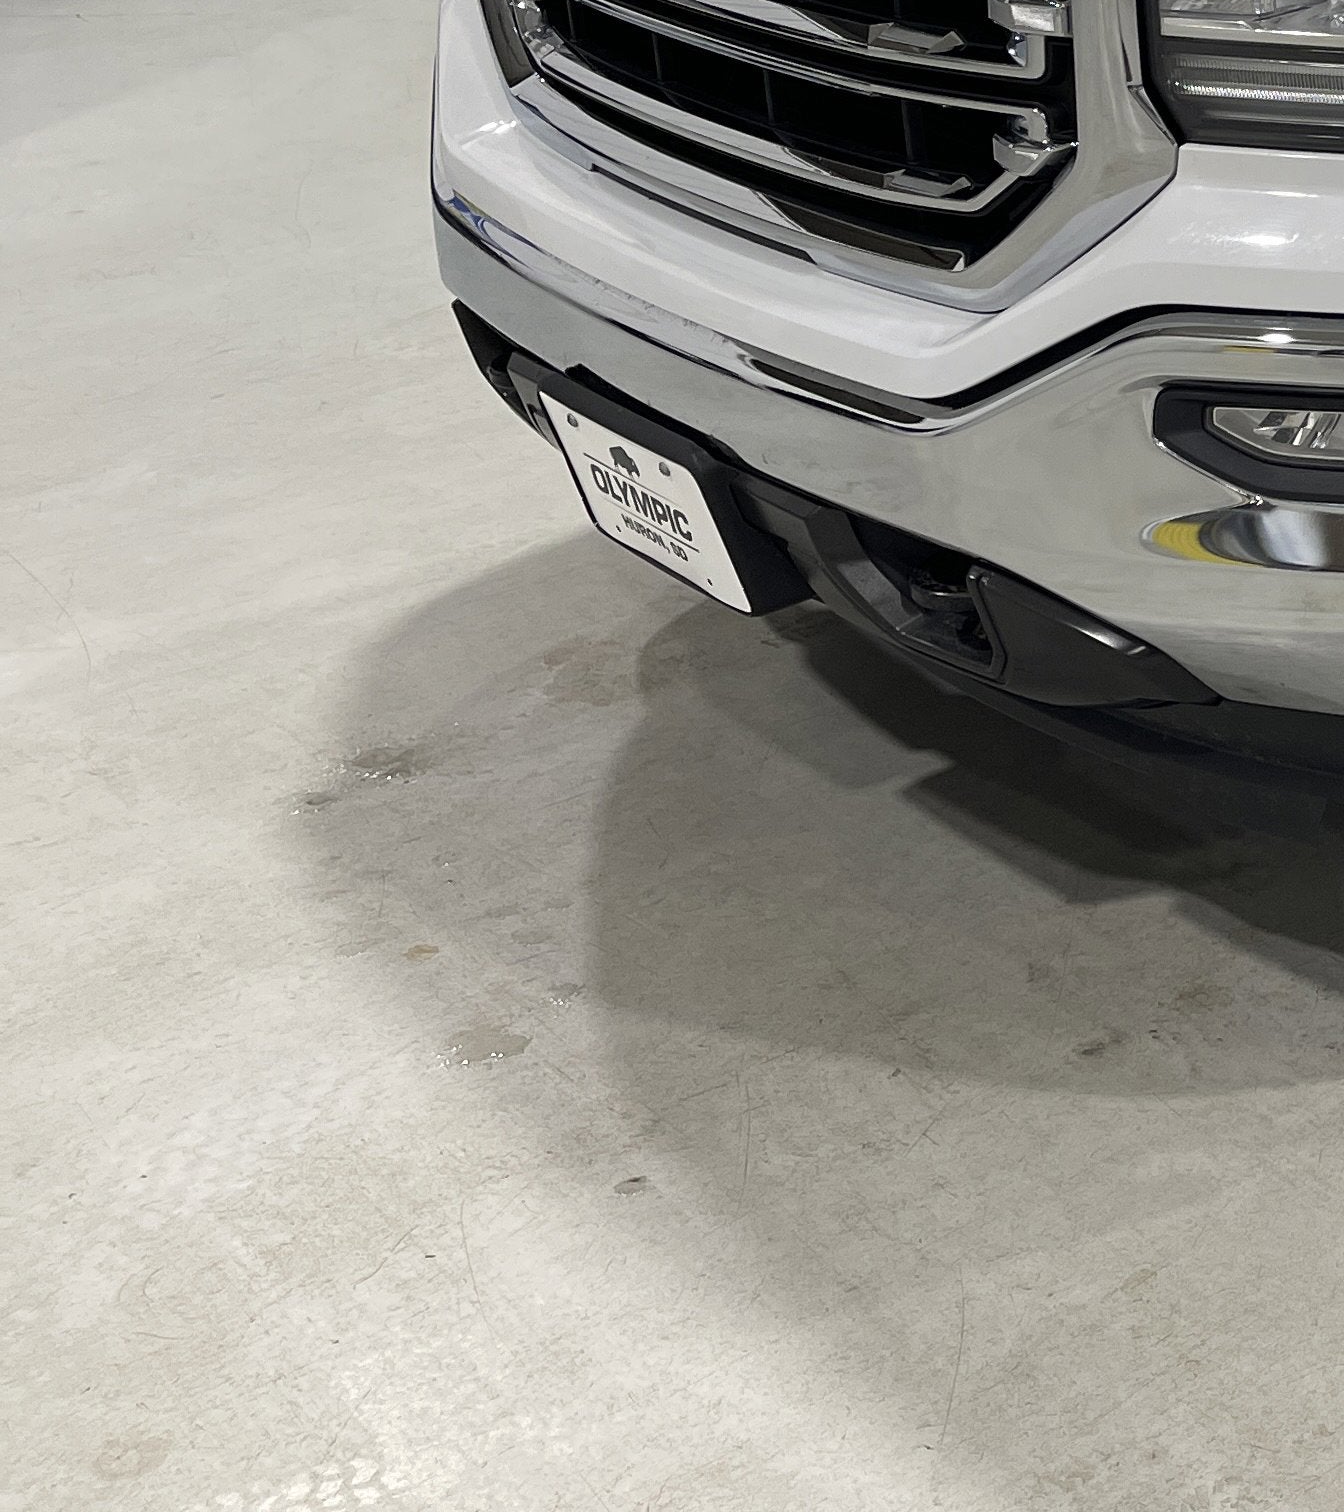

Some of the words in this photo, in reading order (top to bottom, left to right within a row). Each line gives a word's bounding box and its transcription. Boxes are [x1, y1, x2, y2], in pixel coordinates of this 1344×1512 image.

[590, 463, 694, 543] OLYMPIC
[620, 513, 671, 554] HURON,
[669, 541, 689, 562] SD
